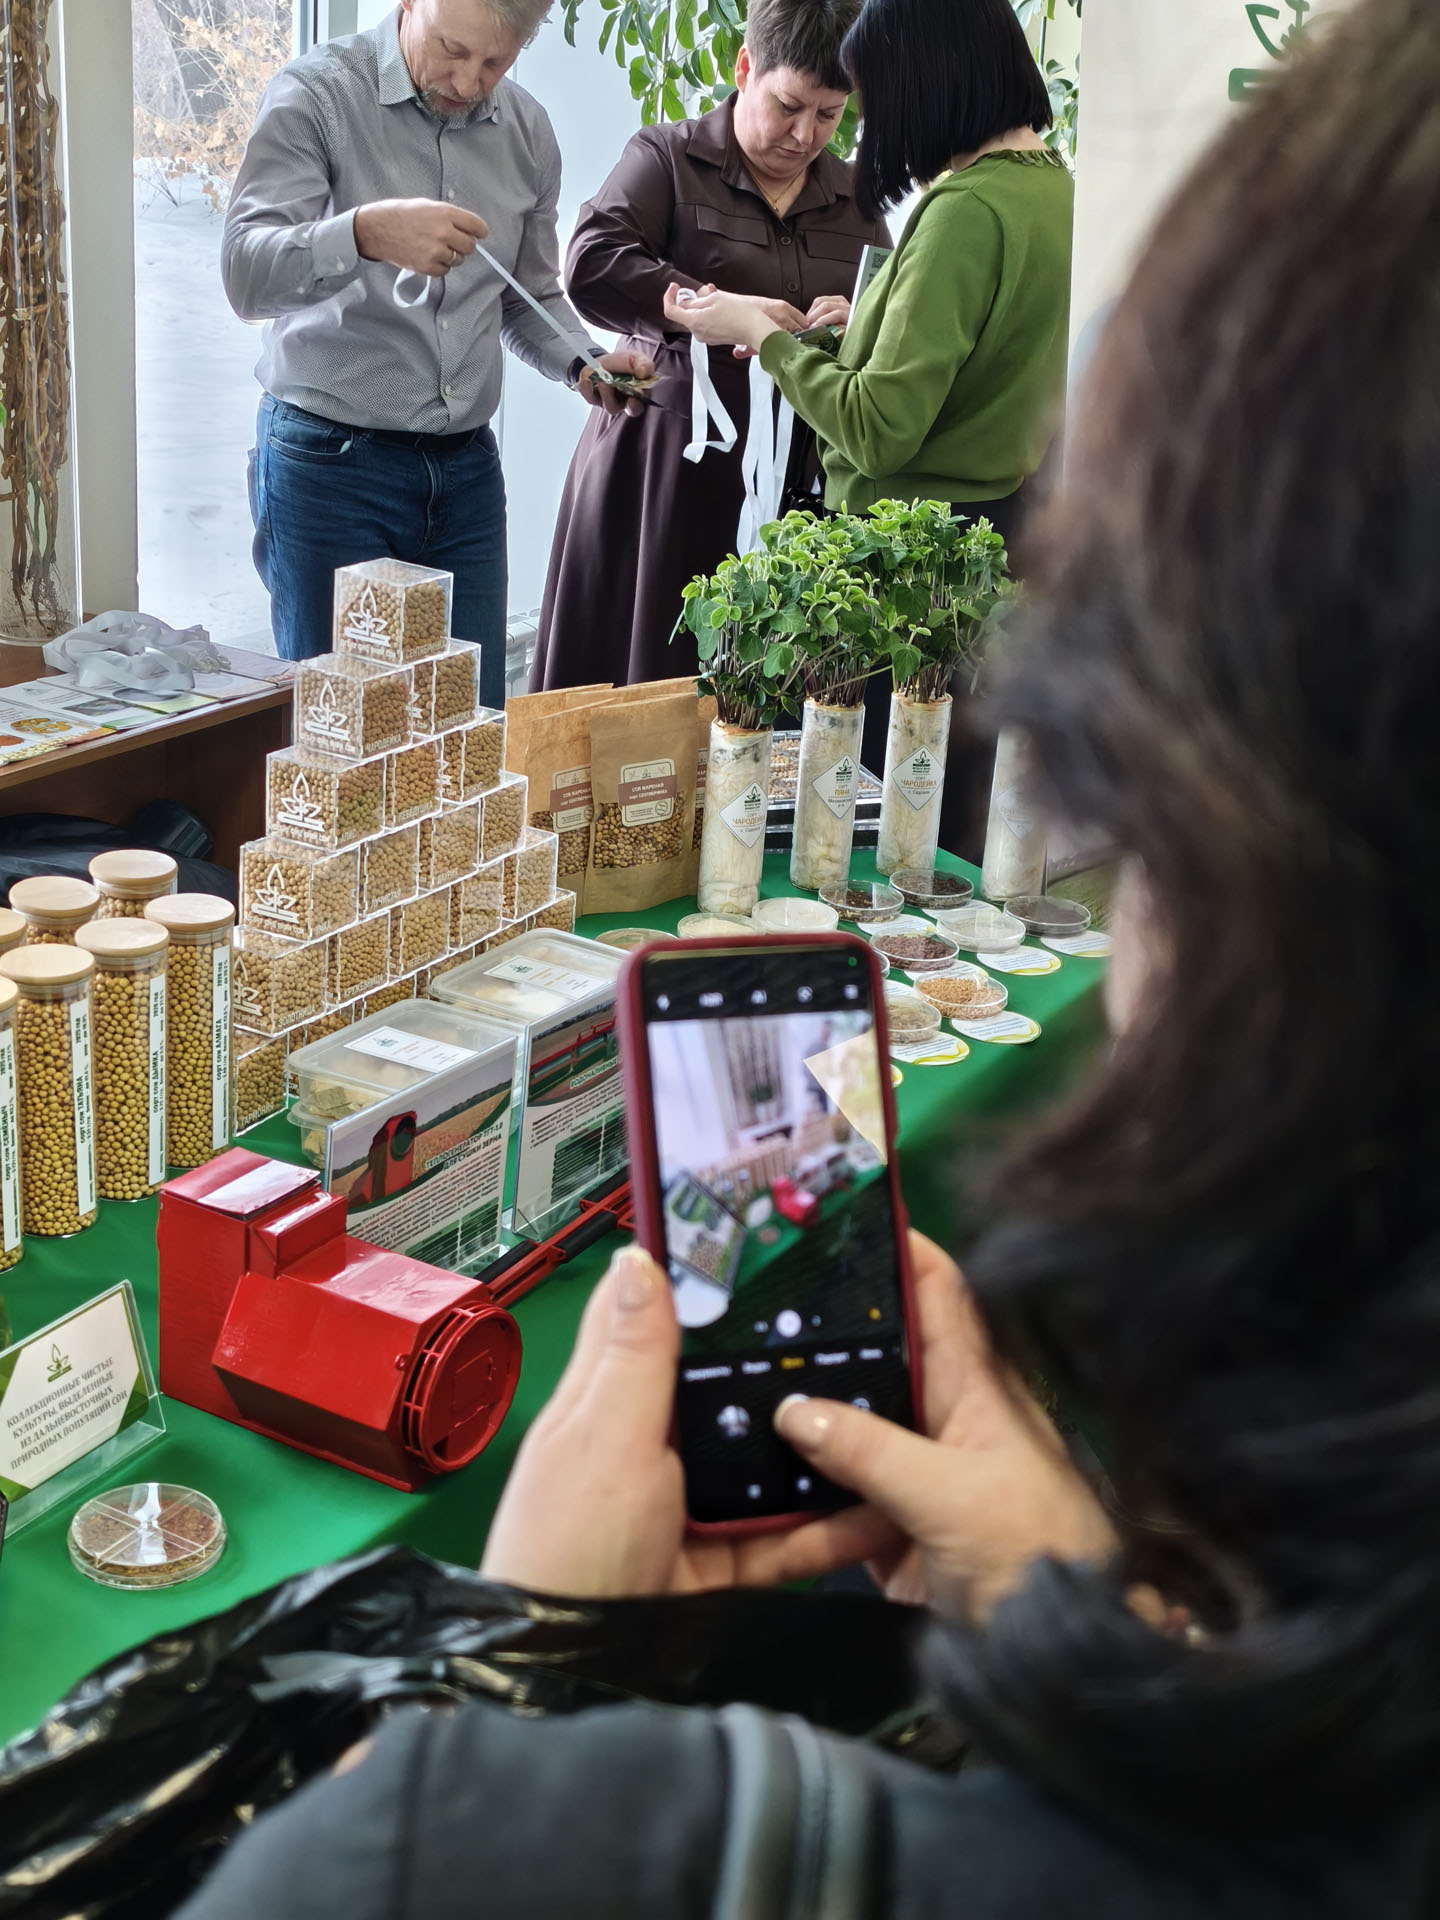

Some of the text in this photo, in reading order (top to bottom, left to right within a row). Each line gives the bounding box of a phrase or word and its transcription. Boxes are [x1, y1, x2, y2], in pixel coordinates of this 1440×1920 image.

[76, 1075, 84, 1110] ТАТЬЯНА
[240, 1101, 274, 1125] ГАРМОНИЯ
[426, 1132, 483, 1168] ТЕПЛОГЕНЕРАТОР
[481, 1133, 502, 1150] ЗЕРНА
[7, 1357, 113, 1428] КОЛЛЕКЦИОННЫЕ ЧИСТЫЕ
[58, 1370, 113, 1410] ВЫДЕЛЕННЫЕ
[10, 1390, 128, 1470] ПРИРОДНЫХ ПОПУЛЯЦИЙ СОИ
[20, 1385, 113, 1450] ИЗ ДАЛЬНЕВОСТОЧНЫХ
